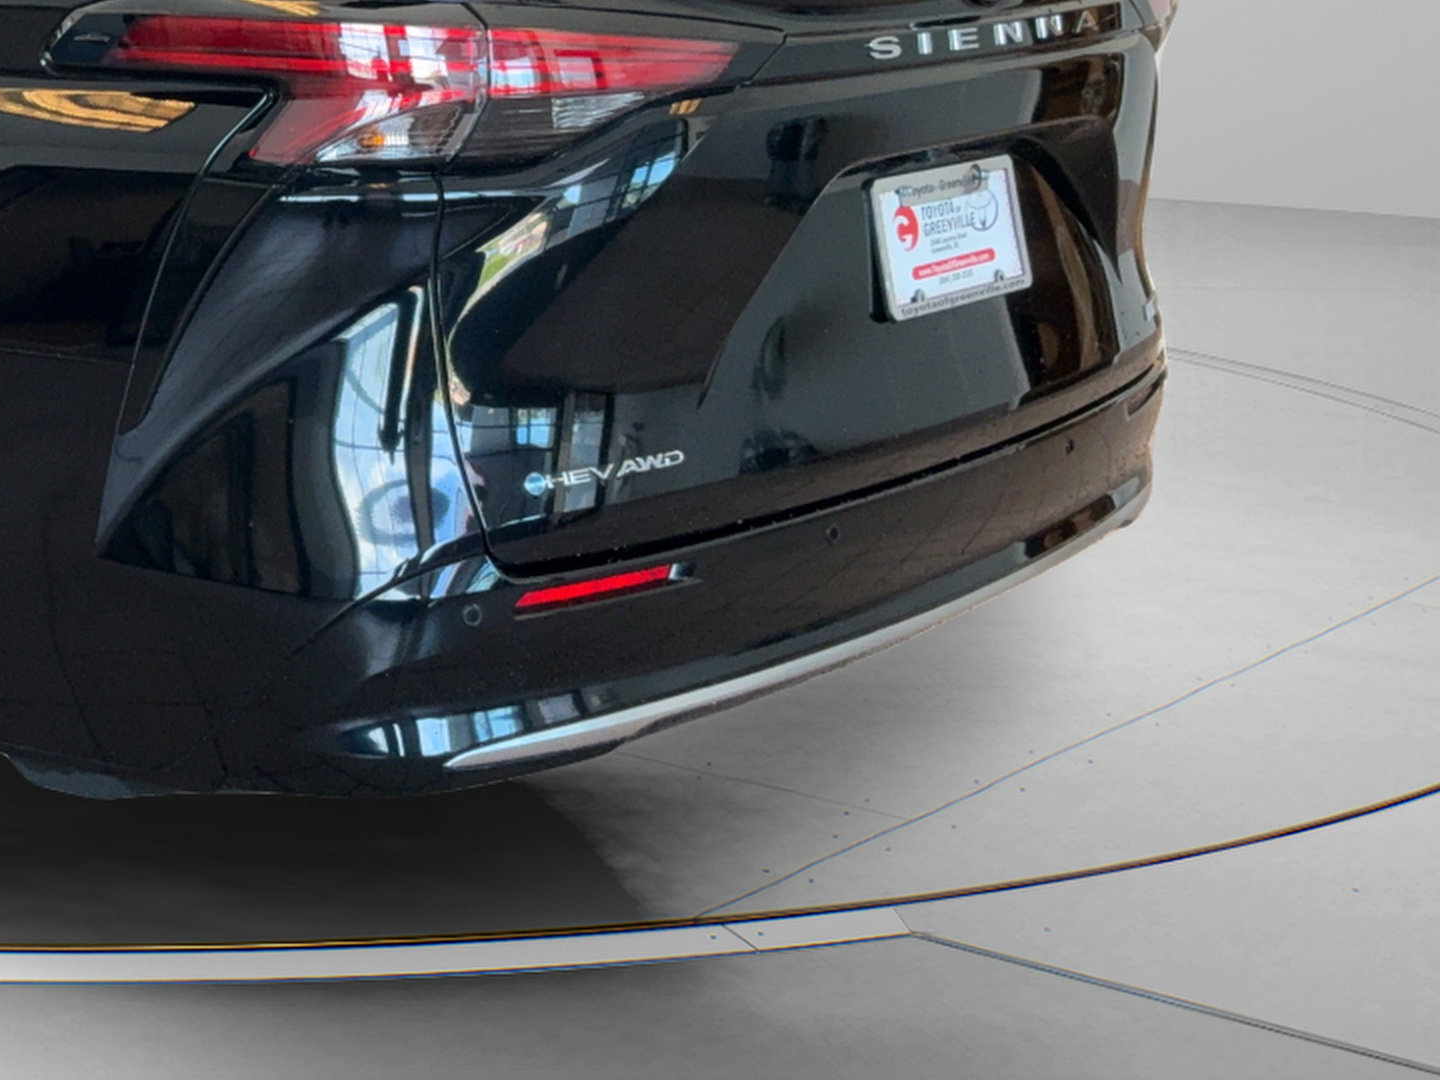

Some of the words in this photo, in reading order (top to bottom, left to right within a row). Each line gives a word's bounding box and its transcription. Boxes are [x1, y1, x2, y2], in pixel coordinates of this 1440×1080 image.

[868, 8, 1100, 60] SIENNA
[920, 201, 955, 220] TOYOTA
[922, 211, 976, 237] GREENVILLE
[616, 449, 686, 478] AWD
